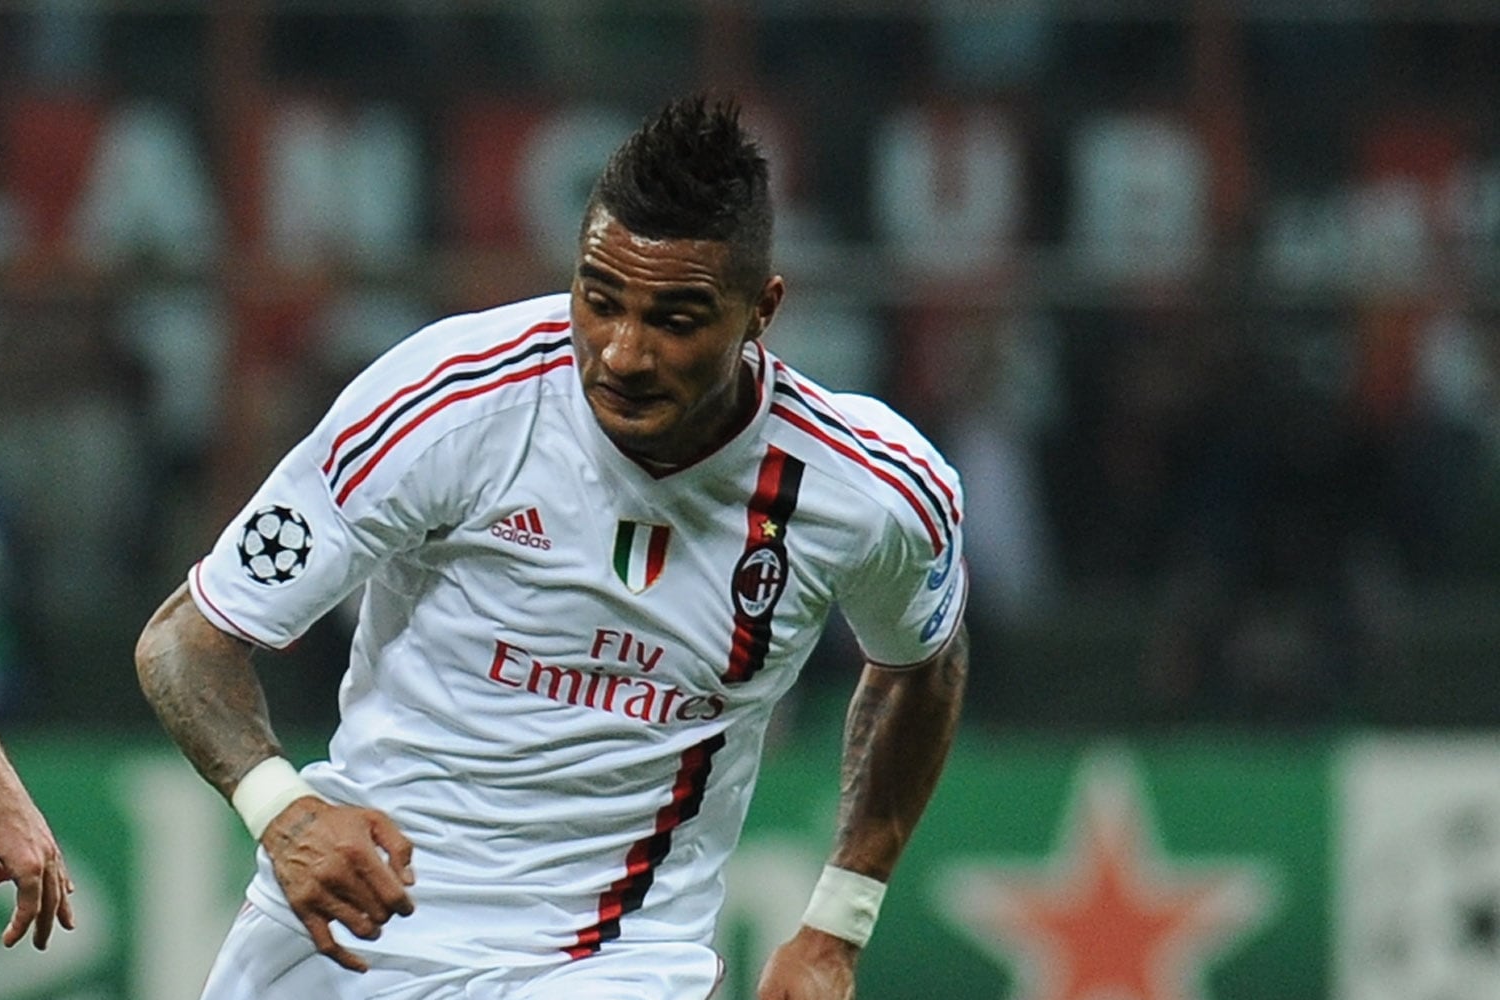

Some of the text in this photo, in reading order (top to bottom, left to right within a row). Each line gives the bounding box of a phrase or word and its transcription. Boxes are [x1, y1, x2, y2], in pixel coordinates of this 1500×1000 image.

[490, 523, 552, 551] adidas
[589, 627, 666, 674] Fly
[487, 638, 730, 725] Emirates
